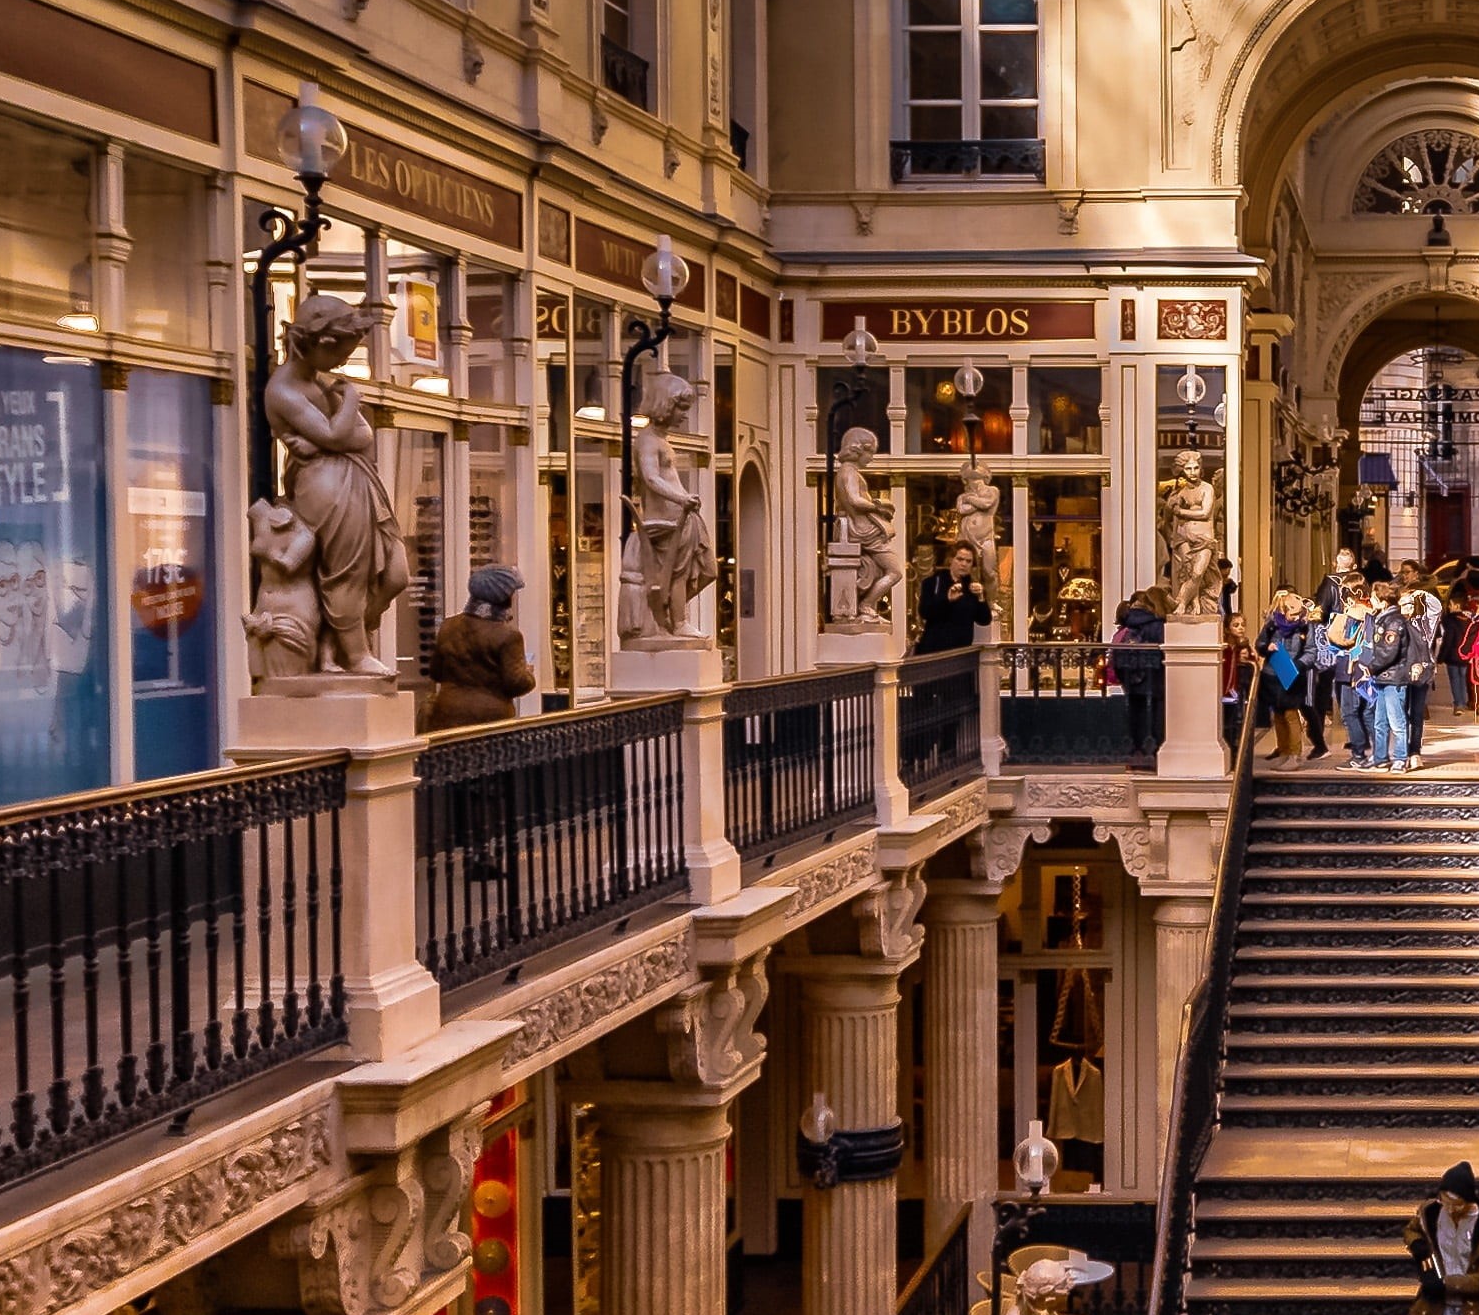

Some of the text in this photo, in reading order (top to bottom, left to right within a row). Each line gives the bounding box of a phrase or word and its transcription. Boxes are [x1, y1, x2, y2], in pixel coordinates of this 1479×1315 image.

[348, 140, 495, 228] LES OPTICIENS
[889, 307, 1030, 336] BYBLOS
[1, 390, 36, 416] YEUX
